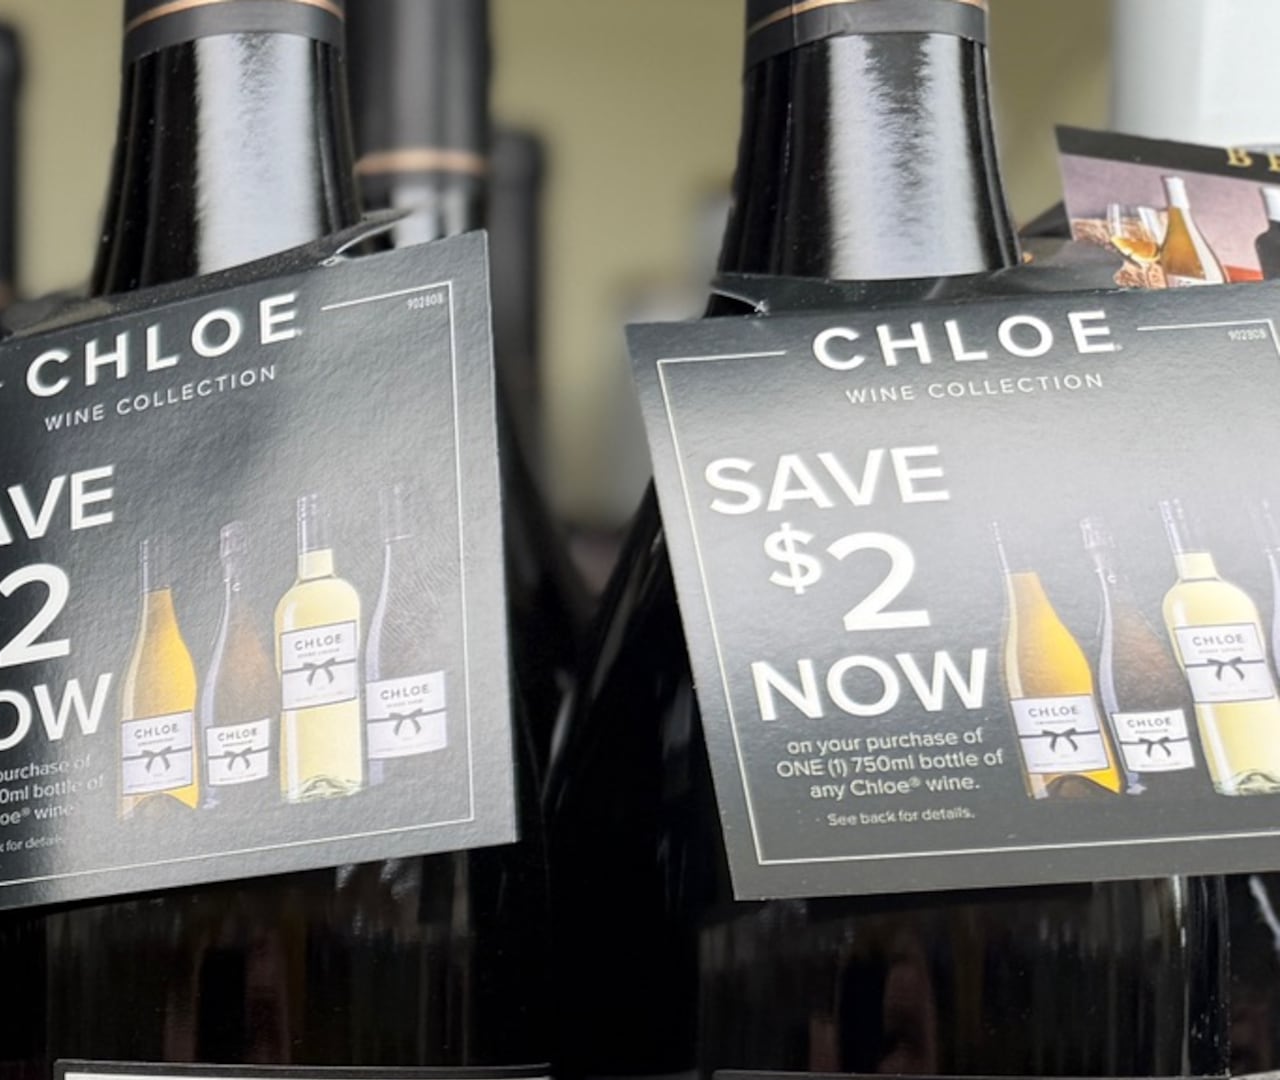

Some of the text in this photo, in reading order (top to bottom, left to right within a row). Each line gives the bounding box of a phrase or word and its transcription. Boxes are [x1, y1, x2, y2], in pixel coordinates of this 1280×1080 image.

[26, 292, 302, 398] CHLOE
[812, 309, 1117, 371] CHLOE
[45, 364, 277, 432] WINE COLLECTION
[846, 372, 1105, 404] WINE COLLECTION
[704, 446, 951, 516] SAVE
[763, 523, 932, 633] $2
[294, 633, 342, 651] CHLOE
[1192, 633, 1246, 647] CHLOE
[380, 683, 430, 701] CHLOE
[752, 648, 988, 721] NOW
[1028, 704, 1080, 718] CHLOE
[134, 723, 180, 740] CHLOE
[1127, 716, 1172, 729] CHLOE
[217, 727, 258, 742] CHLOE
[788, 727, 984, 756] on your purchase of
[73, 754, 91, 768] of
[776, 748, 1004, 778] ONE (1) 750ml bottle of
[33, 778, 83, 799] bottle
[810, 783, 845, 801] any
[926, 775, 981, 793] wine.
[828, 807, 975, 827] See back for details.
[6, 838, 23, 851] for
